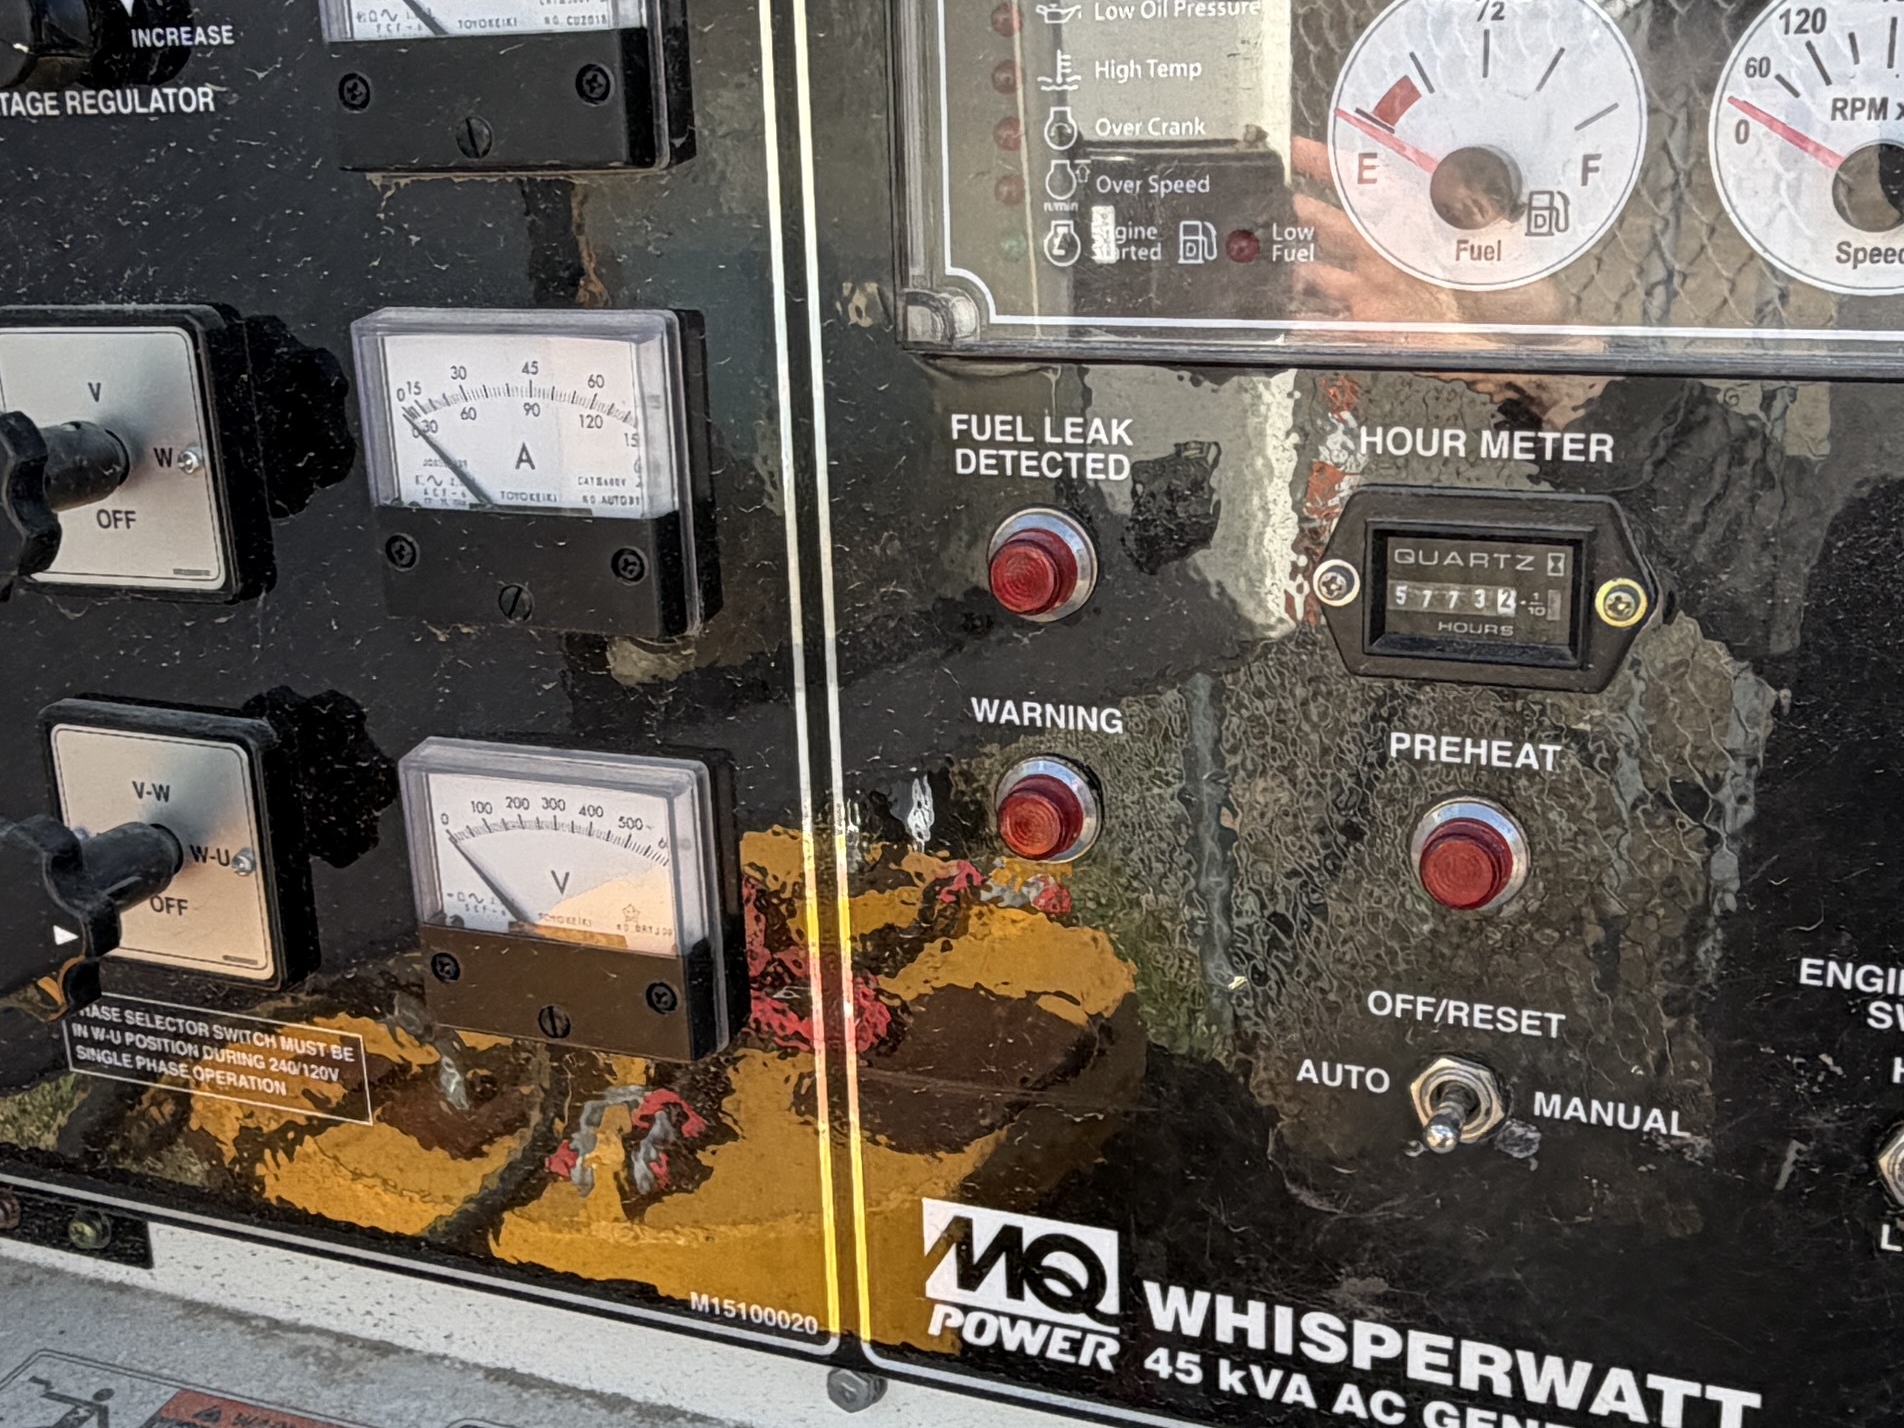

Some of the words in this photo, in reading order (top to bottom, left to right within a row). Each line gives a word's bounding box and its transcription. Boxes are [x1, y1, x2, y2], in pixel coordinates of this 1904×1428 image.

[1095, 2, 1135, 20] Low
[1141, 0, 1167, 18] Oil
[1174, 0, 1261, 17] Pressure
[1779, 7, 1826, 35] 120
[132, 25, 234, 48] INCREASE
[1095, 60, 1141, 83] High
[1147, 60, 1202, 80] Temp
[1746, 56, 1771, 78] 60
[66, 87, 215, 114] REGULATOR
[1830, 98, 1888, 121] RPM
[1096, 118, 1142, 137] Over
[1148, 117, 1206, 136] Crank
[1735, 120, 1750, 144] 0
[1357, 153, 1377, 184] E
[1581, 154, 1602, 186] F
[1096, 176, 1144, 193] Over
[1148, 176, 1210, 197] Speed
[1272, 224, 1314, 240] Low
[1272, 245, 1314, 262] Fuel
[1456, 240, 1501, 261] Fuel
[450, 366, 467, 380] 30
[522, 361, 539, 375] 45
[88, 382, 101, 402] V
[407, 381, 421, 395] 15
[587, 374, 604, 388] 60
[397, 388, 405, 402] 0
[461, 407, 477, 420] 60
[523, 402, 541, 416] 90
[421, 420, 438, 433] 30
[579, 414, 603, 429] 120
[951, 413, 1034, 443] FUEL
[1043, 416, 1133, 446] LEAK
[624, 433, 639, 448] 15
[1359, 426, 1466, 456] HOUR
[1480, 429, 1614, 462] METER
[154, 447, 173, 467] W
[515, 443, 536, 470] A
[955, 448, 1131, 481] DETECTED
[96, 509, 137, 530] OFF
[1394, 549, 1535, 571] QUARTZ
[1438, 622, 1514, 636] HOURS
[971, 697, 1123, 734] WARNING
[1389, 732, 1562, 772] PREHEAT
[132, 780, 170, 802] V-W
[471, 800, 492, 815] 100
[506, 796, 530, 810] 200
[542, 797, 566, 811] 300
[578, 805, 604, 818] 400
[441, 813, 448, 825] 0
[618, 816, 643, 830] 500
[190, 844, 230, 867] W-U
[551, 870, 570, 894] V
[150, 896, 188, 916] OFF
[1367, 990, 1565, 1040] OFF/RESET
[79, 1003, 121, 1023] HASE
[124, 1009, 210, 1037] SELECTOR
[212, 1024, 277, 1049] SWITCH
[280, 1037, 325, 1057] MUST
[331, 1045, 355, 1062] BE
[72, 1023, 88, 1039] IN
[92, 1025, 121, 1044] W-U
[125, 1031, 199, 1058] POSITION
[202, 1045, 265, 1069] DURING
[269, 1056, 339, 1082] 240/120V
[76, 1045, 133, 1068] SINGLE
[136, 1056, 189, 1077] PHASE
[192, 1067, 286, 1096] OPERATION
[1296, 1059, 1390, 1094] AUTO
[1533, 1091, 1691, 1137] MANUAL
[924, 1215, 1119, 1324] MQ
[690, 1292, 818, 1335] M15100020
[928, 1304, 1120, 1373] POWER
[1143, 1348, 1204, 1386] 45
[1217, 1359, 1317, 1410] kVA
[1330, 1384, 1406, 1427] AC
